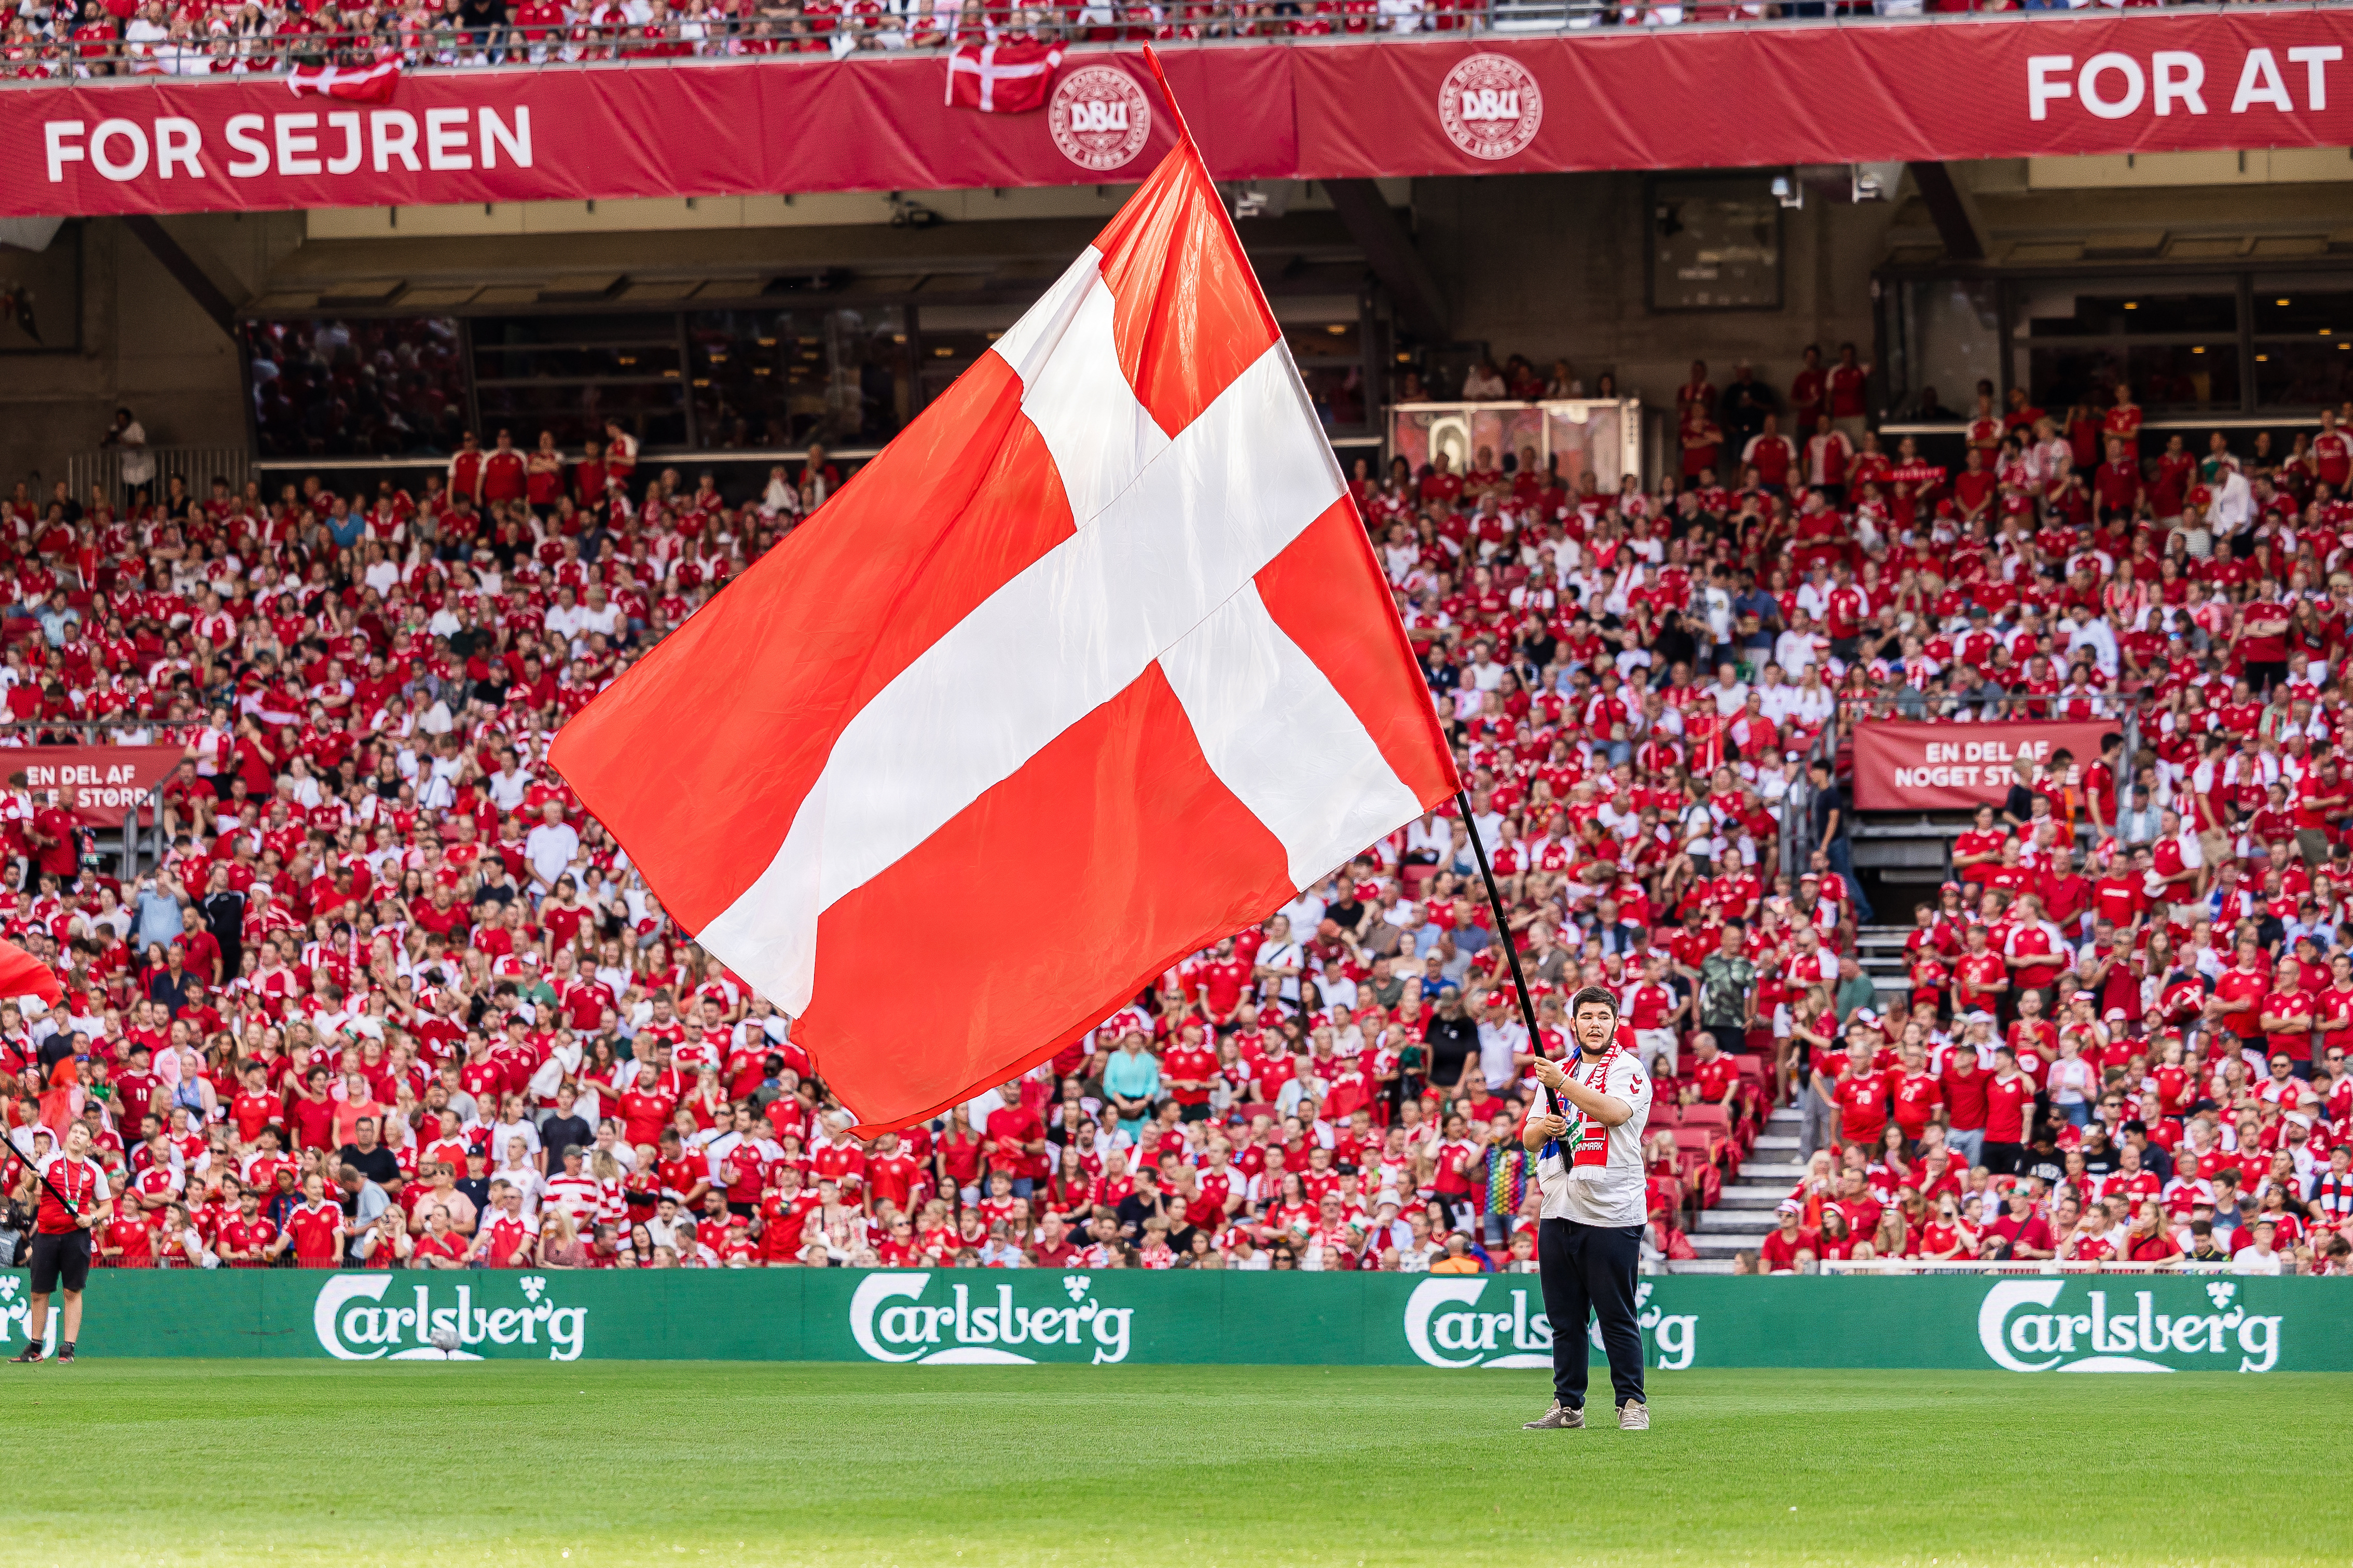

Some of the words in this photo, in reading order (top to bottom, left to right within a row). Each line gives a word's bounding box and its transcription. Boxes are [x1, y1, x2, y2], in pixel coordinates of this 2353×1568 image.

[2028, 51, 2208, 121] FOR
[2230, 46, 2344, 114] AT
[1070, 100, 1129, 132] DBU
[1462, 88, 1521, 121] DBU
[45, 117, 207, 183] FOR
[225, 105, 534, 178] SEJREN
[1925, 742, 1959, 763] EN
[1964, 741, 2013, 762] DEL
[2017, 740, 2050, 761] AF
[26, 765, 56, 786] EN
[61, 764, 104, 785] DEL
[106, 764, 135, 785] AF
[1894, 766, 1980, 787] NOGET
[135, 1088, 147, 1102] 11
[1575, 1142, 1604, 1152] ANMARK
[313, 1273, 588, 1361] Carlsberg
[849, 1272, 1135, 1365] Carlsberg
[1978, 1279, 2283, 1373] Carlsberg
